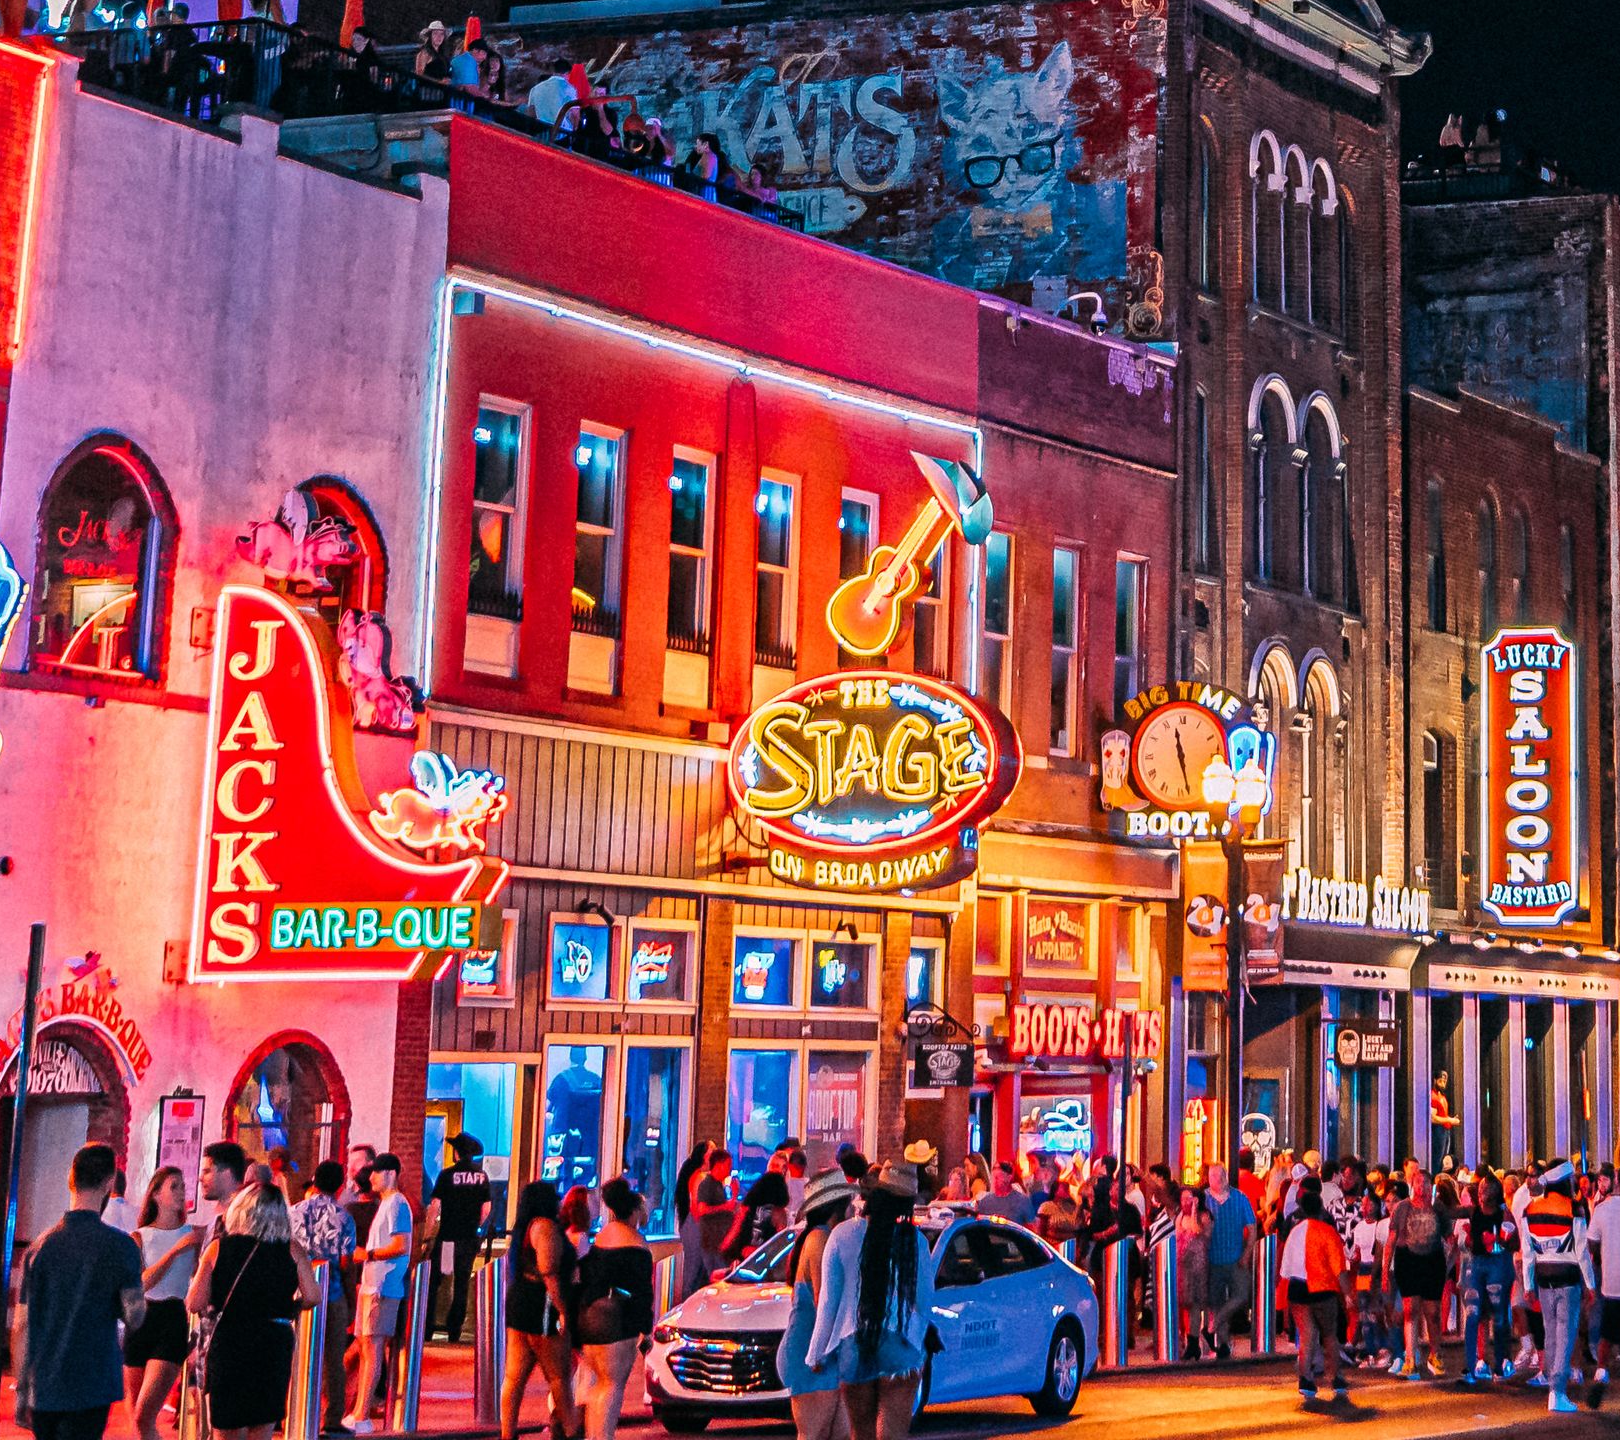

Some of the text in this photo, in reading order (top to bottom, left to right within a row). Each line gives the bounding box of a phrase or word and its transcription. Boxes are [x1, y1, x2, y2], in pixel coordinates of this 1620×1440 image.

[1491, 645, 1567, 672] LUCKY
[838, 681, 890, 709] THE
[1123, 681, 1242, 720] BIG TIME
[744, 702, 987, 817] STAGE
[1506, 669, 1551, 884] SALOON
[208, 620, 285, 966] JACKS
[770, 846, 949, 887] ON BROADWAY
[1296, 867, 1430, 933] BASTARD SALOON
[1489, 880, 1572, 907] BASTARD
[270, 906, 474, 950] BAR-B-QUE
[1034, 941, 1077, 962] APPAREL
[1013, 1003, 1162, 1058] BOOTS HTS
[927, 1054, 962, 1069] STAGE
[808, 1089, 858, 1130] ROOFTOP
[822, 1132, 842, 1143] BAR
[963, 1320, 997, 1333] NDOT
